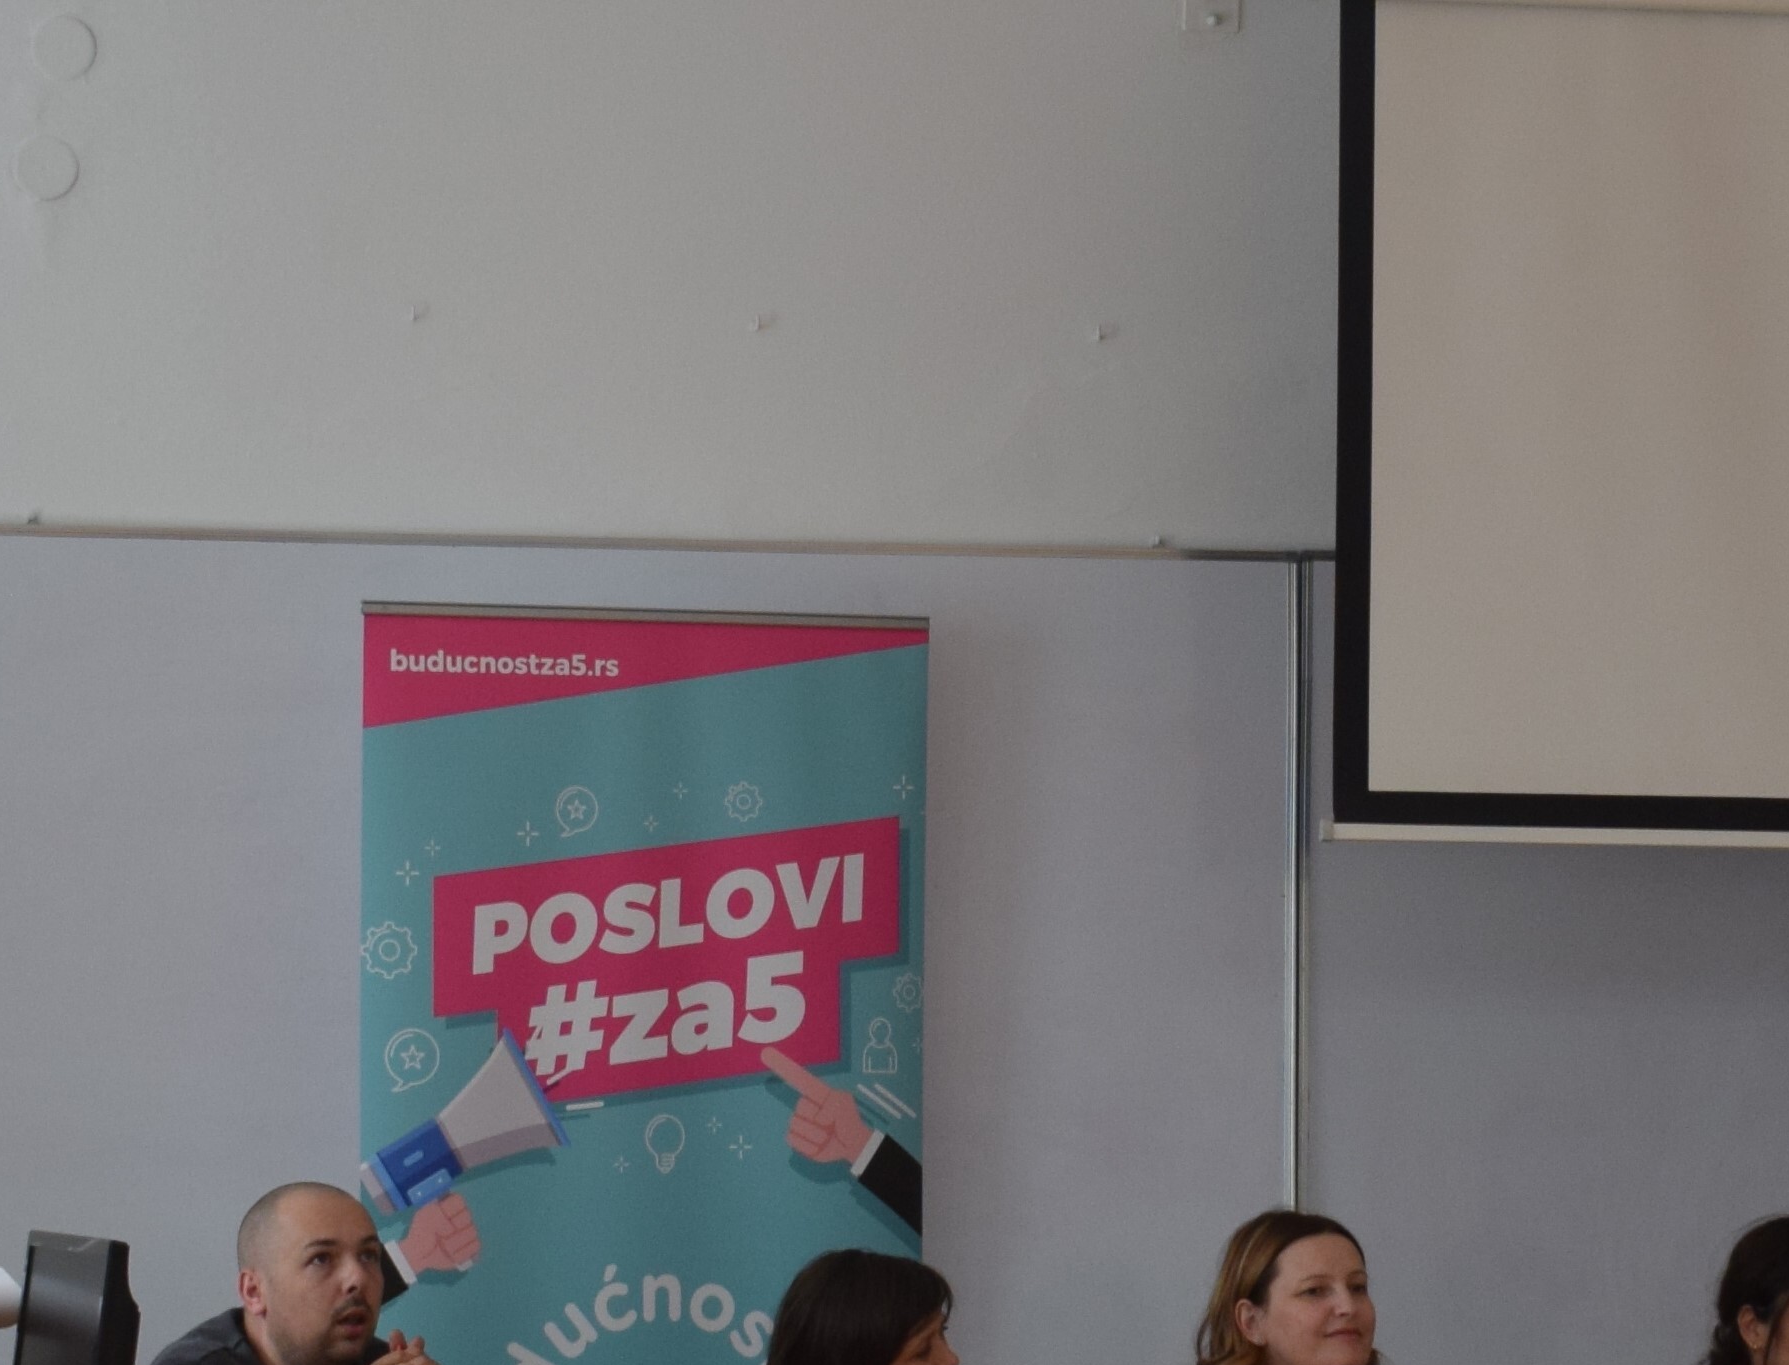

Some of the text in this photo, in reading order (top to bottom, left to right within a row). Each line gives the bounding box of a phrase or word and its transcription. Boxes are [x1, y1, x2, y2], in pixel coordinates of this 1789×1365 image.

[390, 648, 619, 677] buducnostza5.rs
[472, 853, 864, 975] POSLOVI
[525, 950, 806, 1076] #za5
